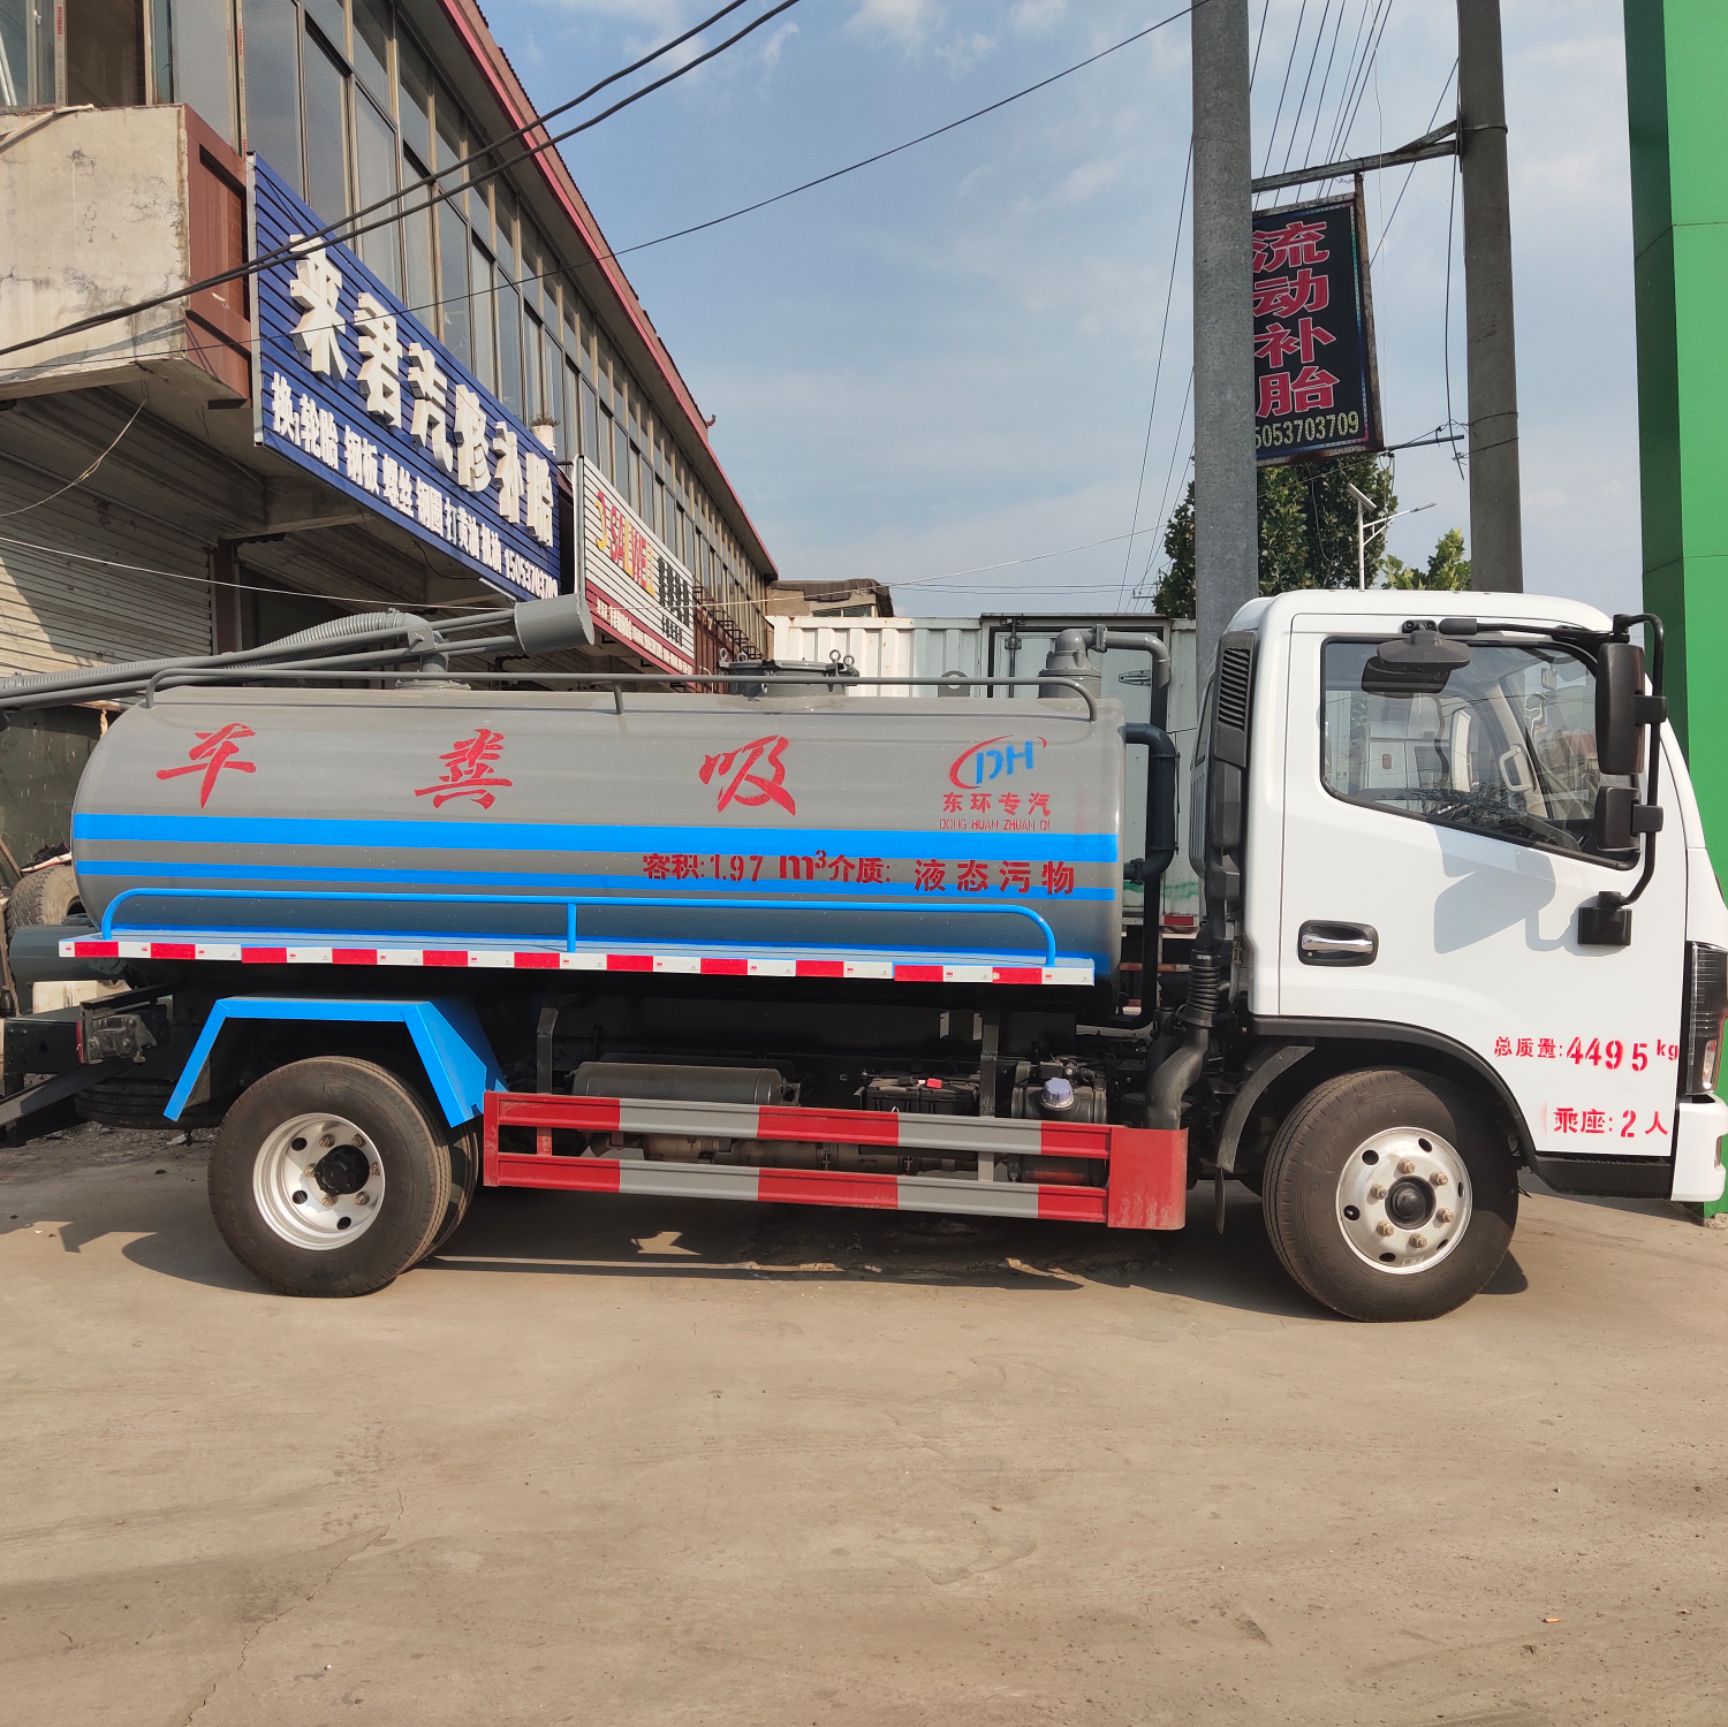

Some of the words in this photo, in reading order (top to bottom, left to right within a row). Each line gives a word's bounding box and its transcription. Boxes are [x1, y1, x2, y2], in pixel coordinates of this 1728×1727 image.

[1252, 220, 1340, 418] 流动补胎
[943, 791, 1051, 817] 东环专汽
[914, 859, 1075, 895] 液态污物
